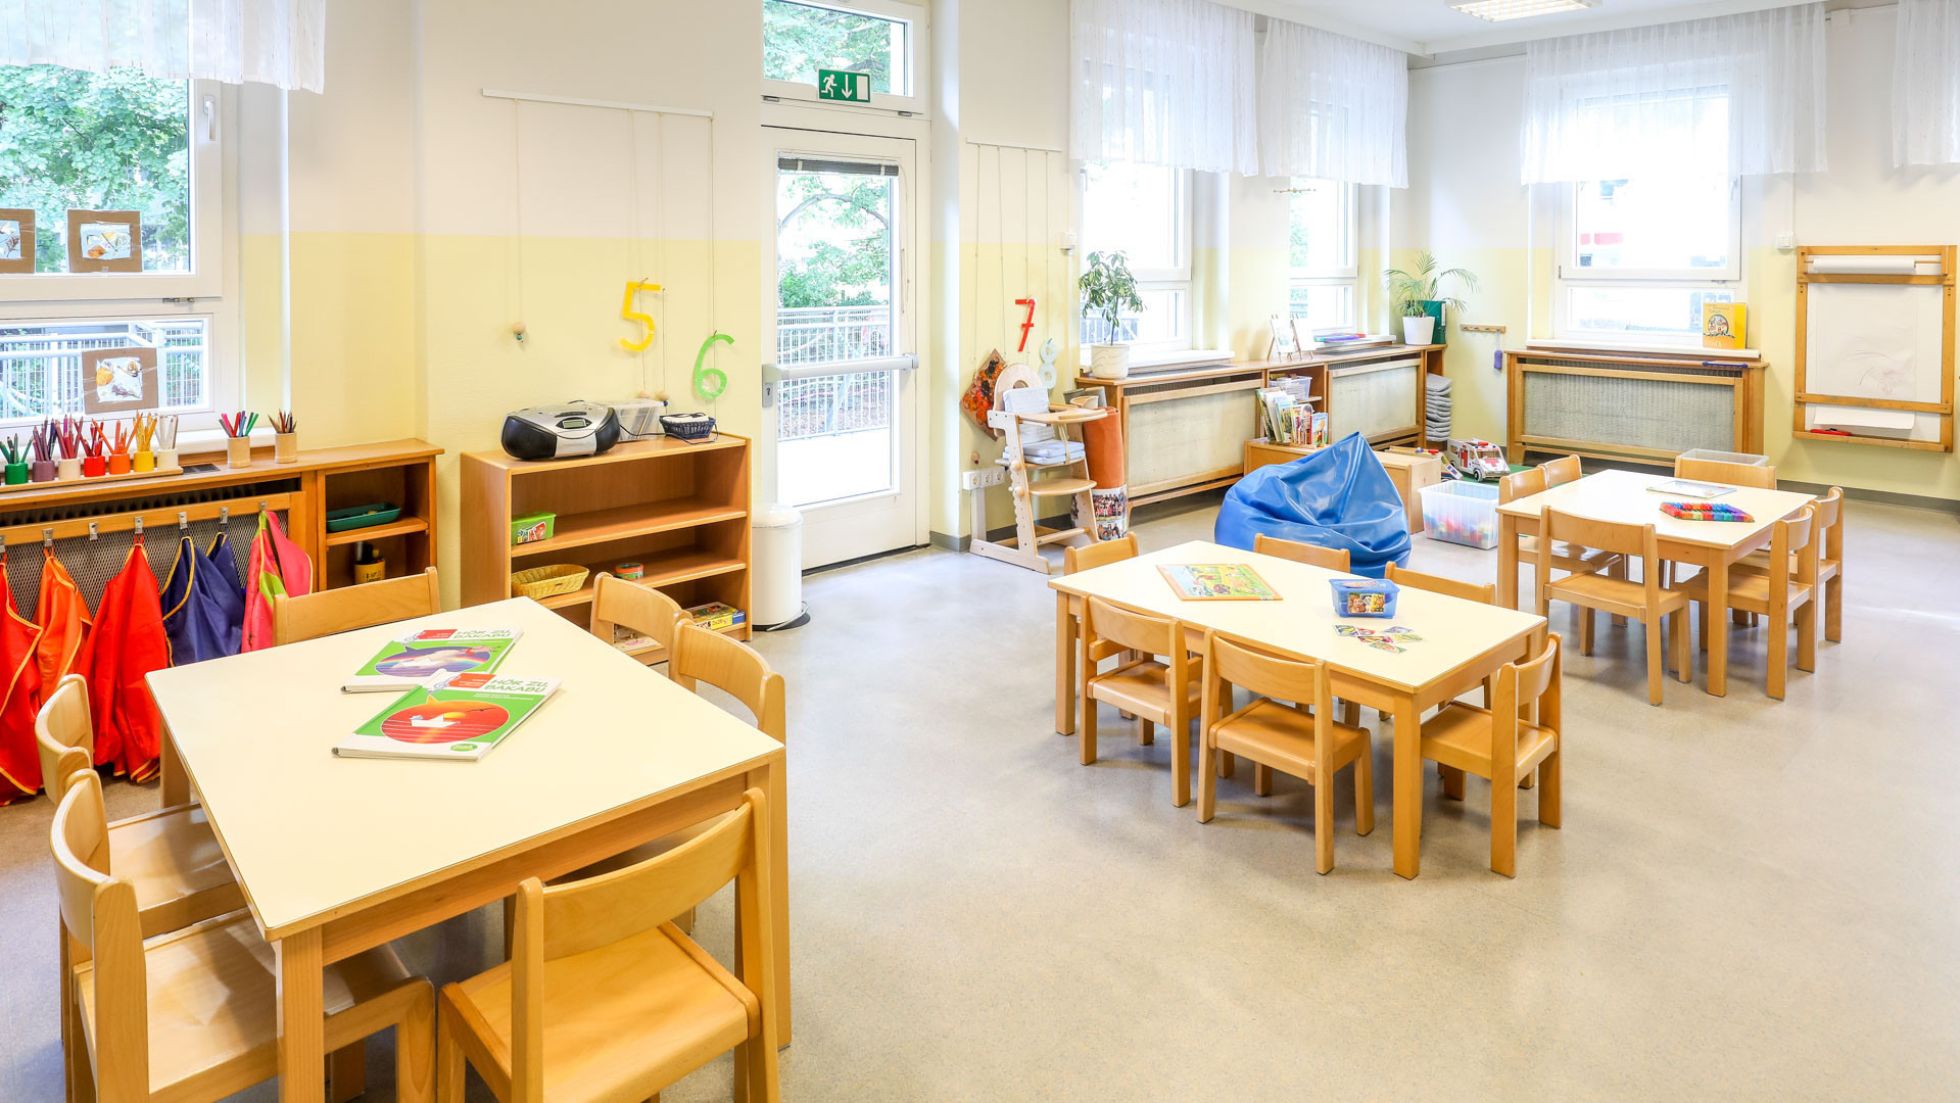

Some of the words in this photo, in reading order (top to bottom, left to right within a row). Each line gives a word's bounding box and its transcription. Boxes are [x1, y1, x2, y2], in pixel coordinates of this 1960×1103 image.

[619, 281, 661, 351] 5
[1015, 299, 1035, 352] 7
[694, 333, 735, 399] 6
[1039, 340, 1057, 389] 8
